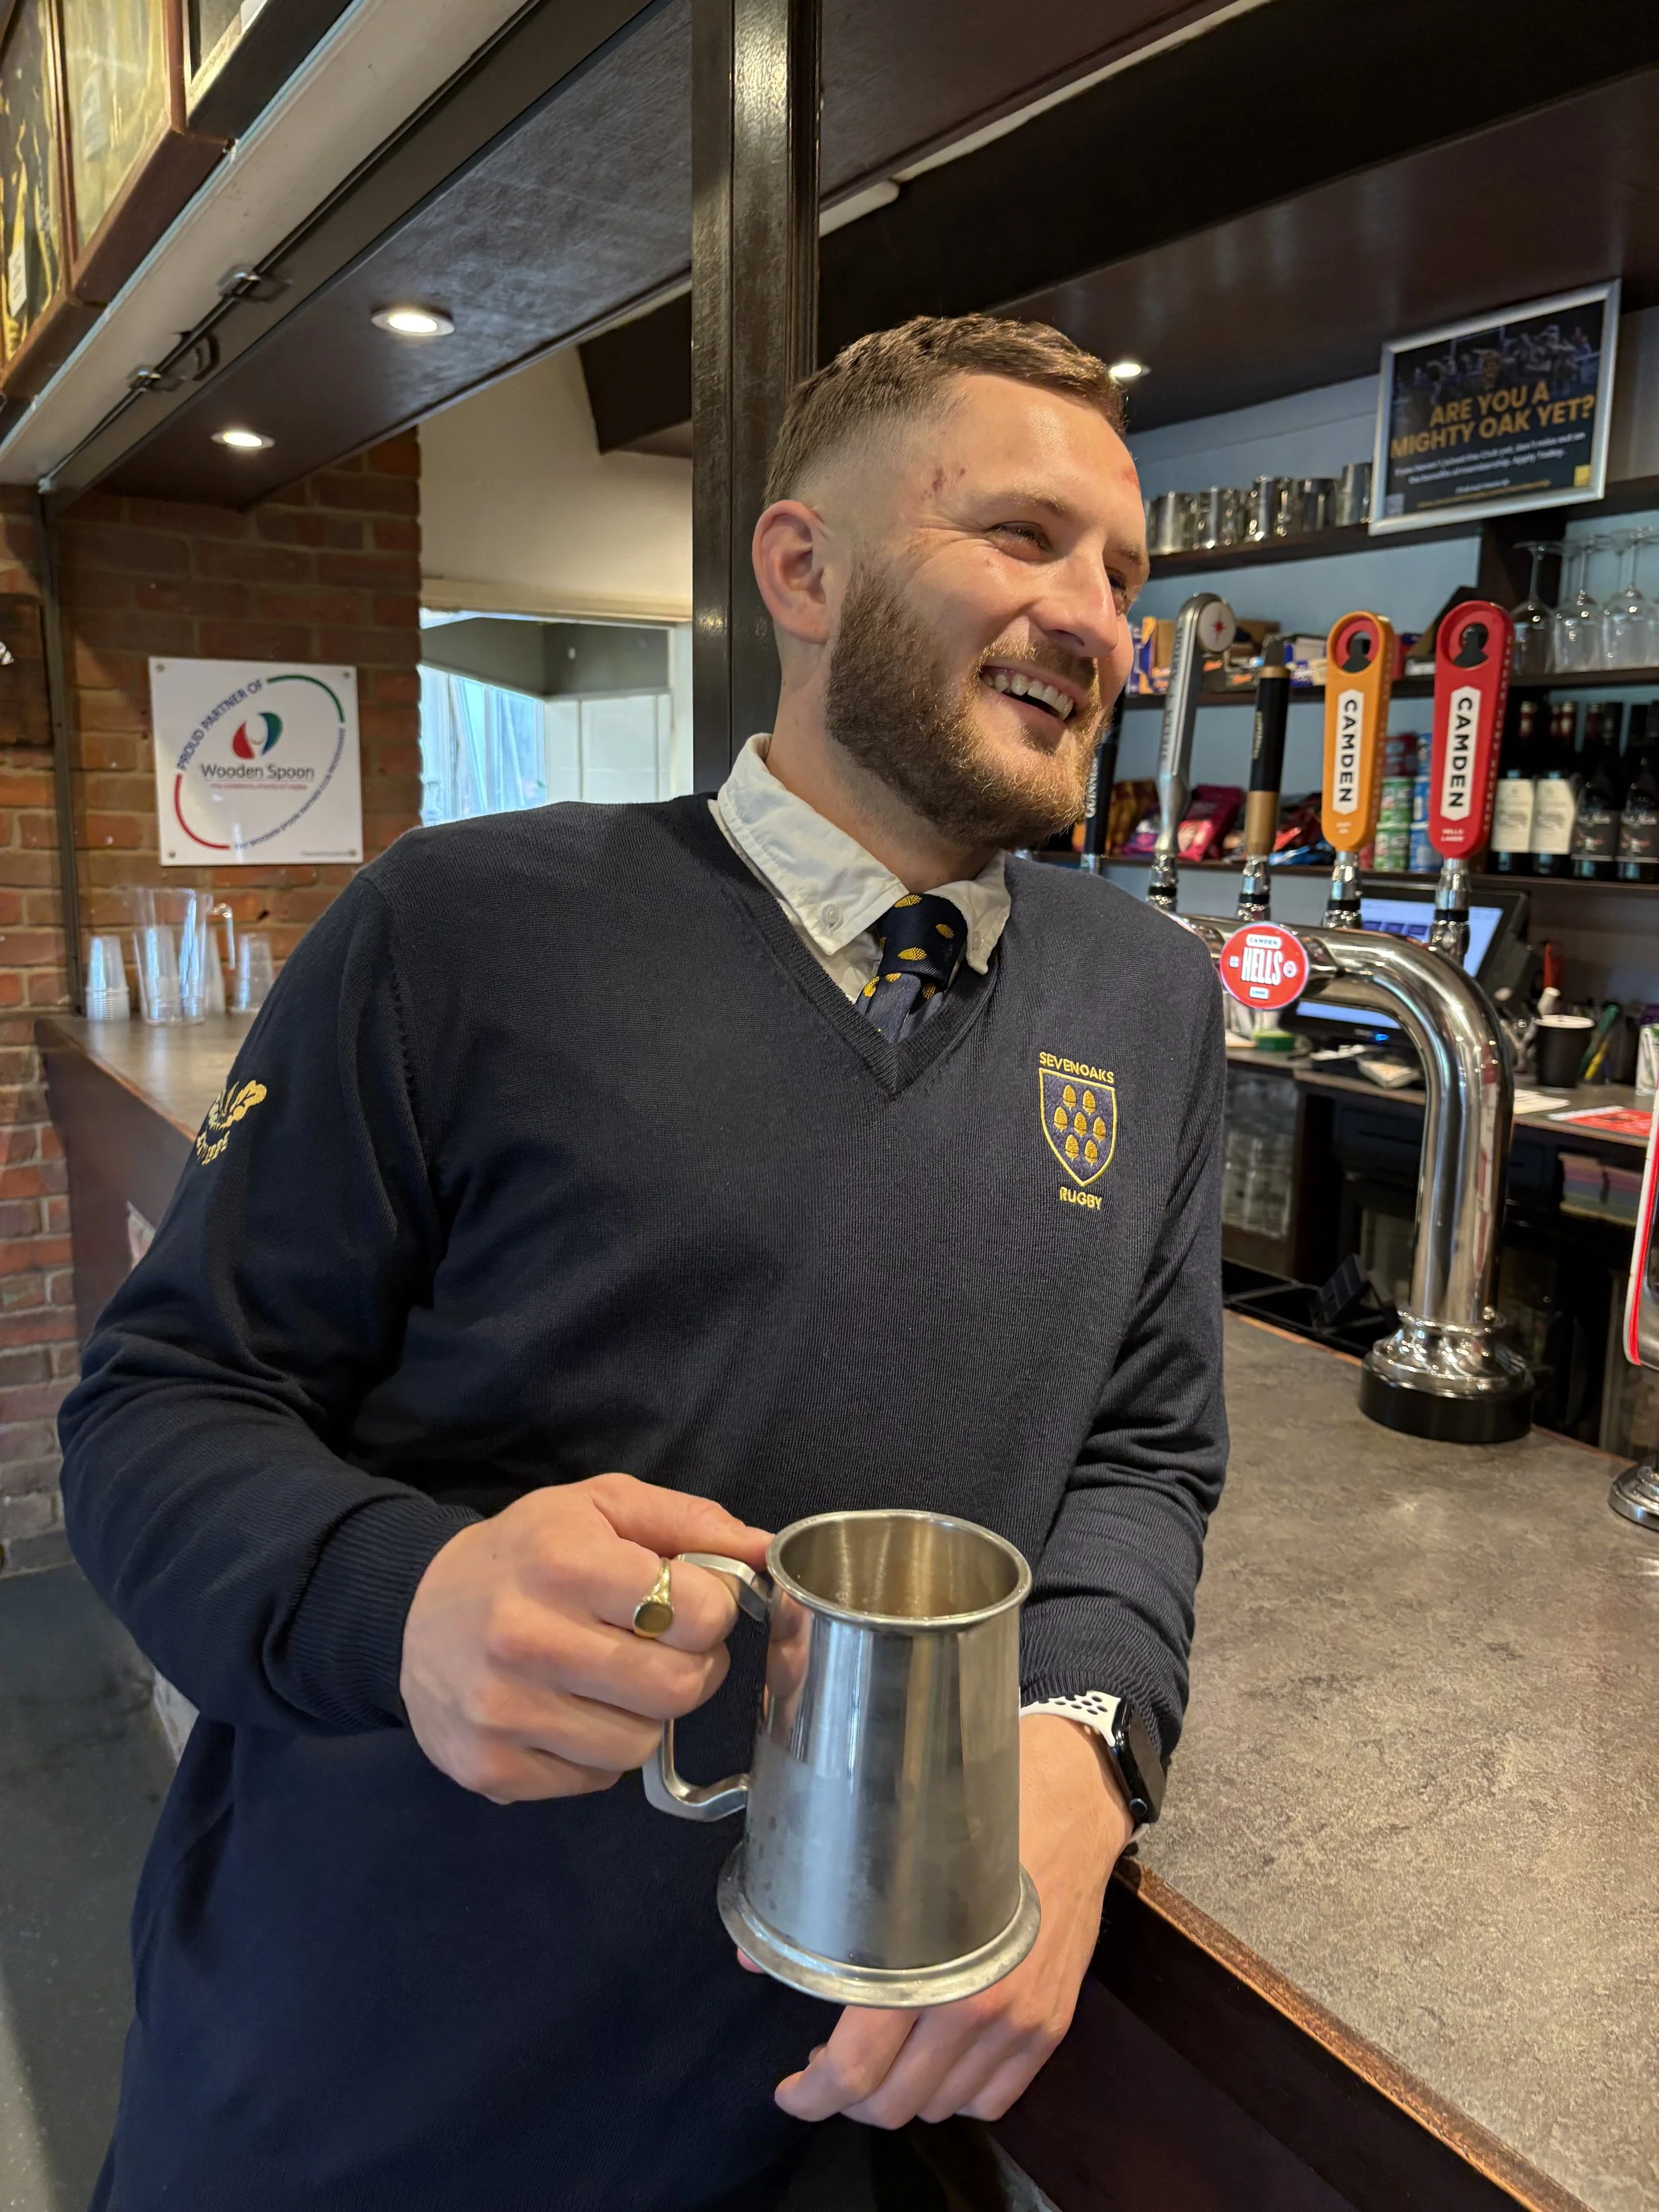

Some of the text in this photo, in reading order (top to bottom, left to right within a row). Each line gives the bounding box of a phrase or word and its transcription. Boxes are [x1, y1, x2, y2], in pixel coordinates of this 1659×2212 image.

[1429, 380, 1550, 428] ARE YOU A
[1390, 394, 1595, 459] MIGHTY OAK YET?
[177, 680, 262, 771] PROUD PARTNER OF
[200, 763, 315, 782] Wooden Spoon
[1339, 699, 1357, 803] CAMDEN
[1449, 697, 1473, 808] CAMDEN
[1250, 937, 1278, 946] CAMDEN
[1241, 947, 1283, 986] HELLS
[1039, 1052, 1115, 1084] SEVENOAKS
[1059, 1187, 1102, 1211] RUGBY
